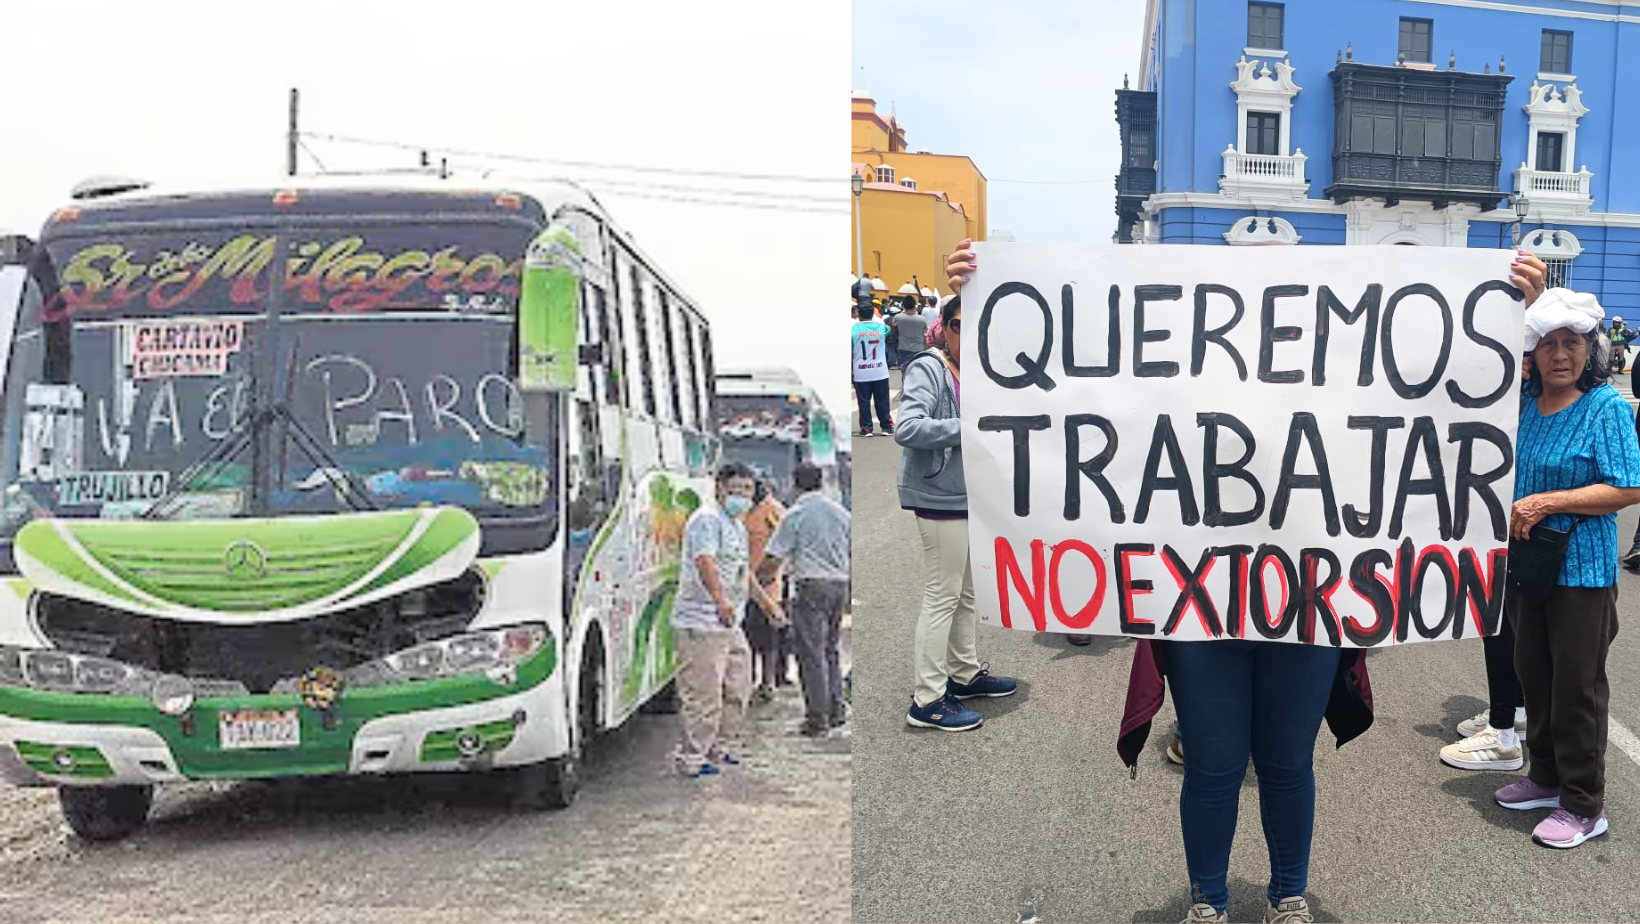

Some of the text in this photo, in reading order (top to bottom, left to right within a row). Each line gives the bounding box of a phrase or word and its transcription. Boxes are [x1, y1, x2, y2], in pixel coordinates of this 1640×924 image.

[860, 339, 880, 361] 17
[978, 279, 1525, 408] QUEREMOS
[306, 355, 524, 445] PARO
[65, 473, 165, 500] TRUJILLO
[978, 412, 1515, 541] TRABAJAR
[994, 535, 1508, 647] NO EXTORSION
